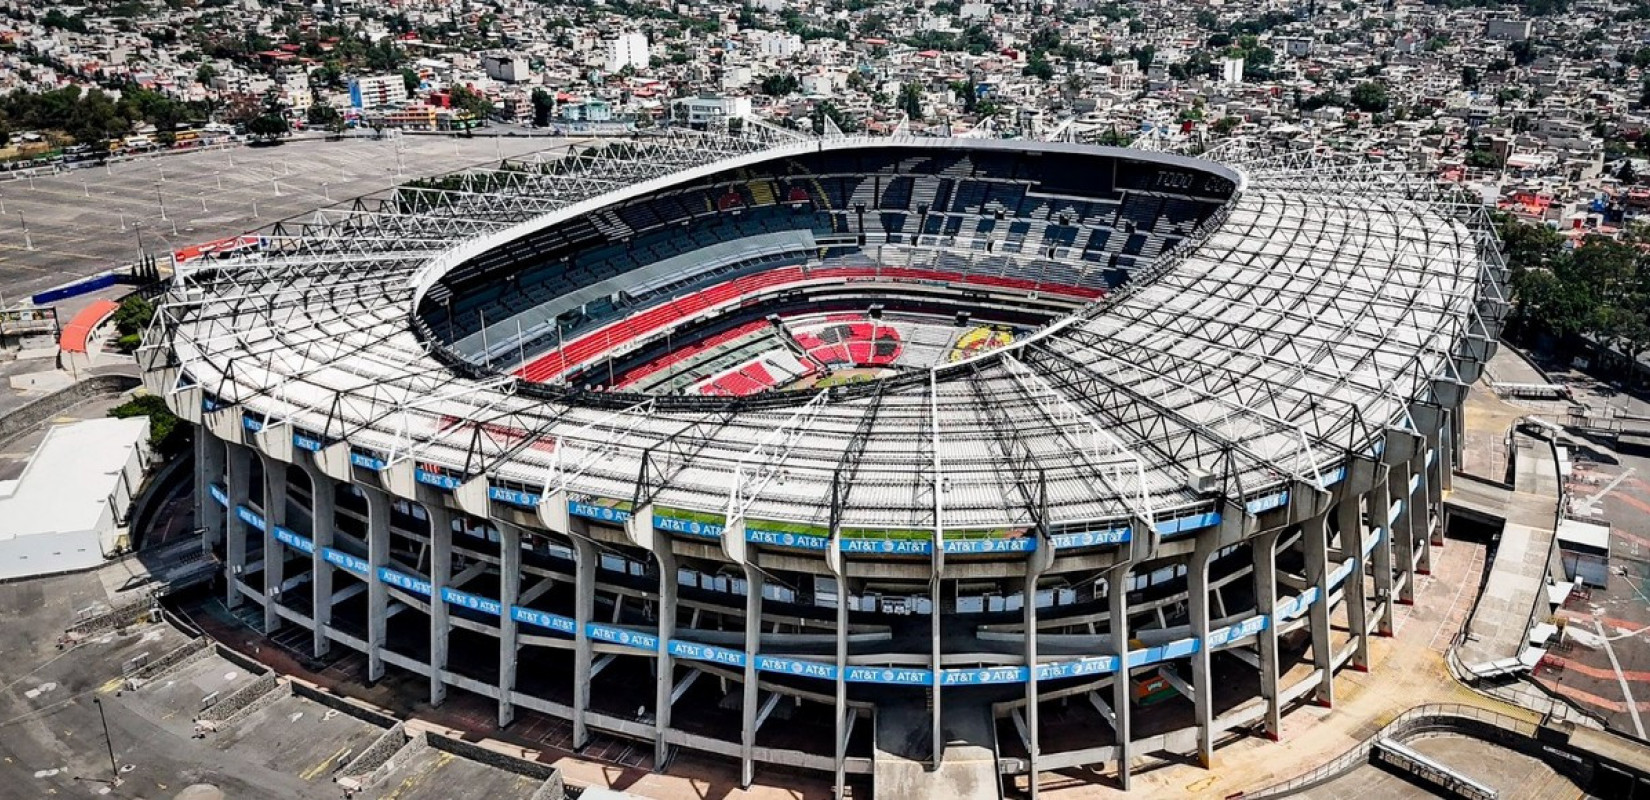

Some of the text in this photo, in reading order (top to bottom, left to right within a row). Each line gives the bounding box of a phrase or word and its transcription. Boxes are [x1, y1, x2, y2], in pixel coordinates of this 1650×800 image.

[1157, 171, 1193, 188] TODO
[356, 456, 373, 468] AT&T
[422, 472, 441, 485] AT&T
[495, 489, 517, 501] AT&T
[575, 505, 631, 522] AT&T AT&
[660, 519, 723, 536] AT&T AT&
[751, 532, 825, 547] AT&T AT&T
[948, 540, 1027, 551] AT&T AT&T
[1050, 531, 1123, 546] AT&T AT&T
[848, 541, 927, 552] AT&T AT&T
[384, 569, 401, 582] AT&T
[448, 592, 501, 613] AT&T AT&T
[517, 611, 574, 631] AT&T AT&T
[593, 628, 655, 647] AT&T AT&T
[675, 644, 741, 663] AT&T AT&T
[761, 659, 832, 677] AT&T AT&T
[1041, 661, 1111, 677] AT&T AT&T
[850, 670, 926, 682] AT&T AT&T
[946, 670, 1021, 683] AT&T AT&T
